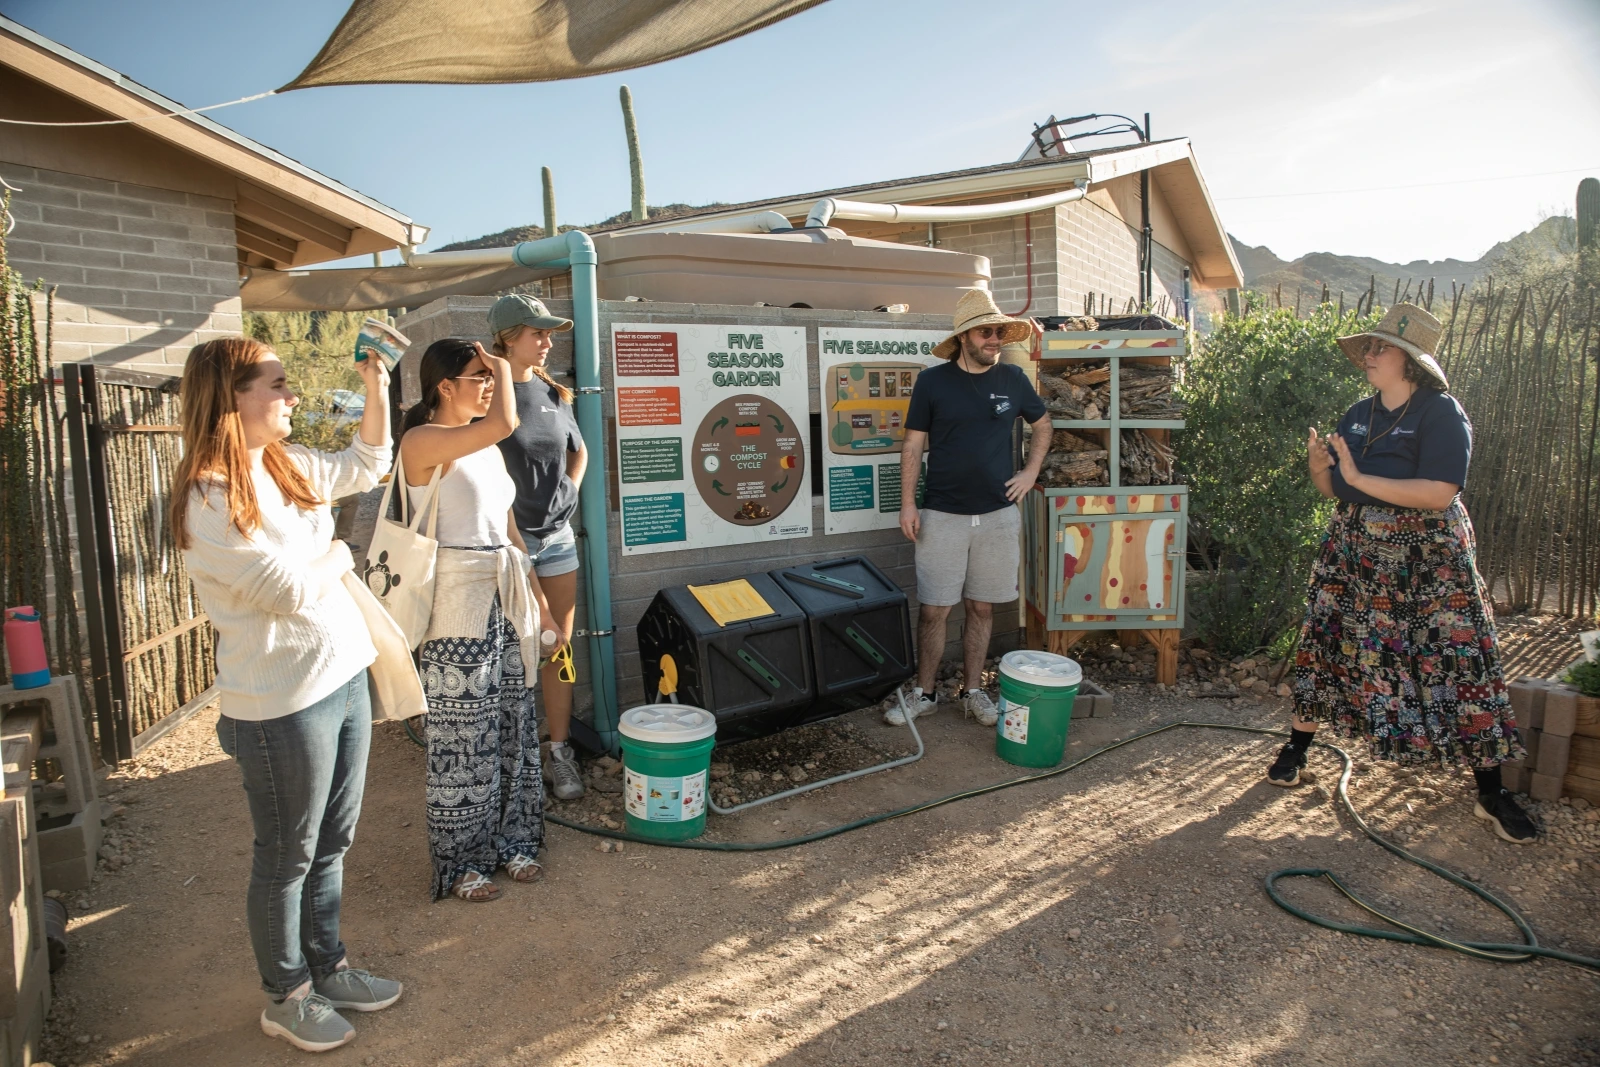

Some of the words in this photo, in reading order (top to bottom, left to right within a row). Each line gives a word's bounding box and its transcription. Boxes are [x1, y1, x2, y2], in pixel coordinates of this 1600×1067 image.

[728, 334, 763, 349] FIVE
[823, 340, 853, 354] FIVE
[857, 340, 918, 354] SEASONS
[708, 352, 784, 368] SEASONS
[712, 371, 780, 387] GARDEN
[730, 453, 767, 461] COMPOST
